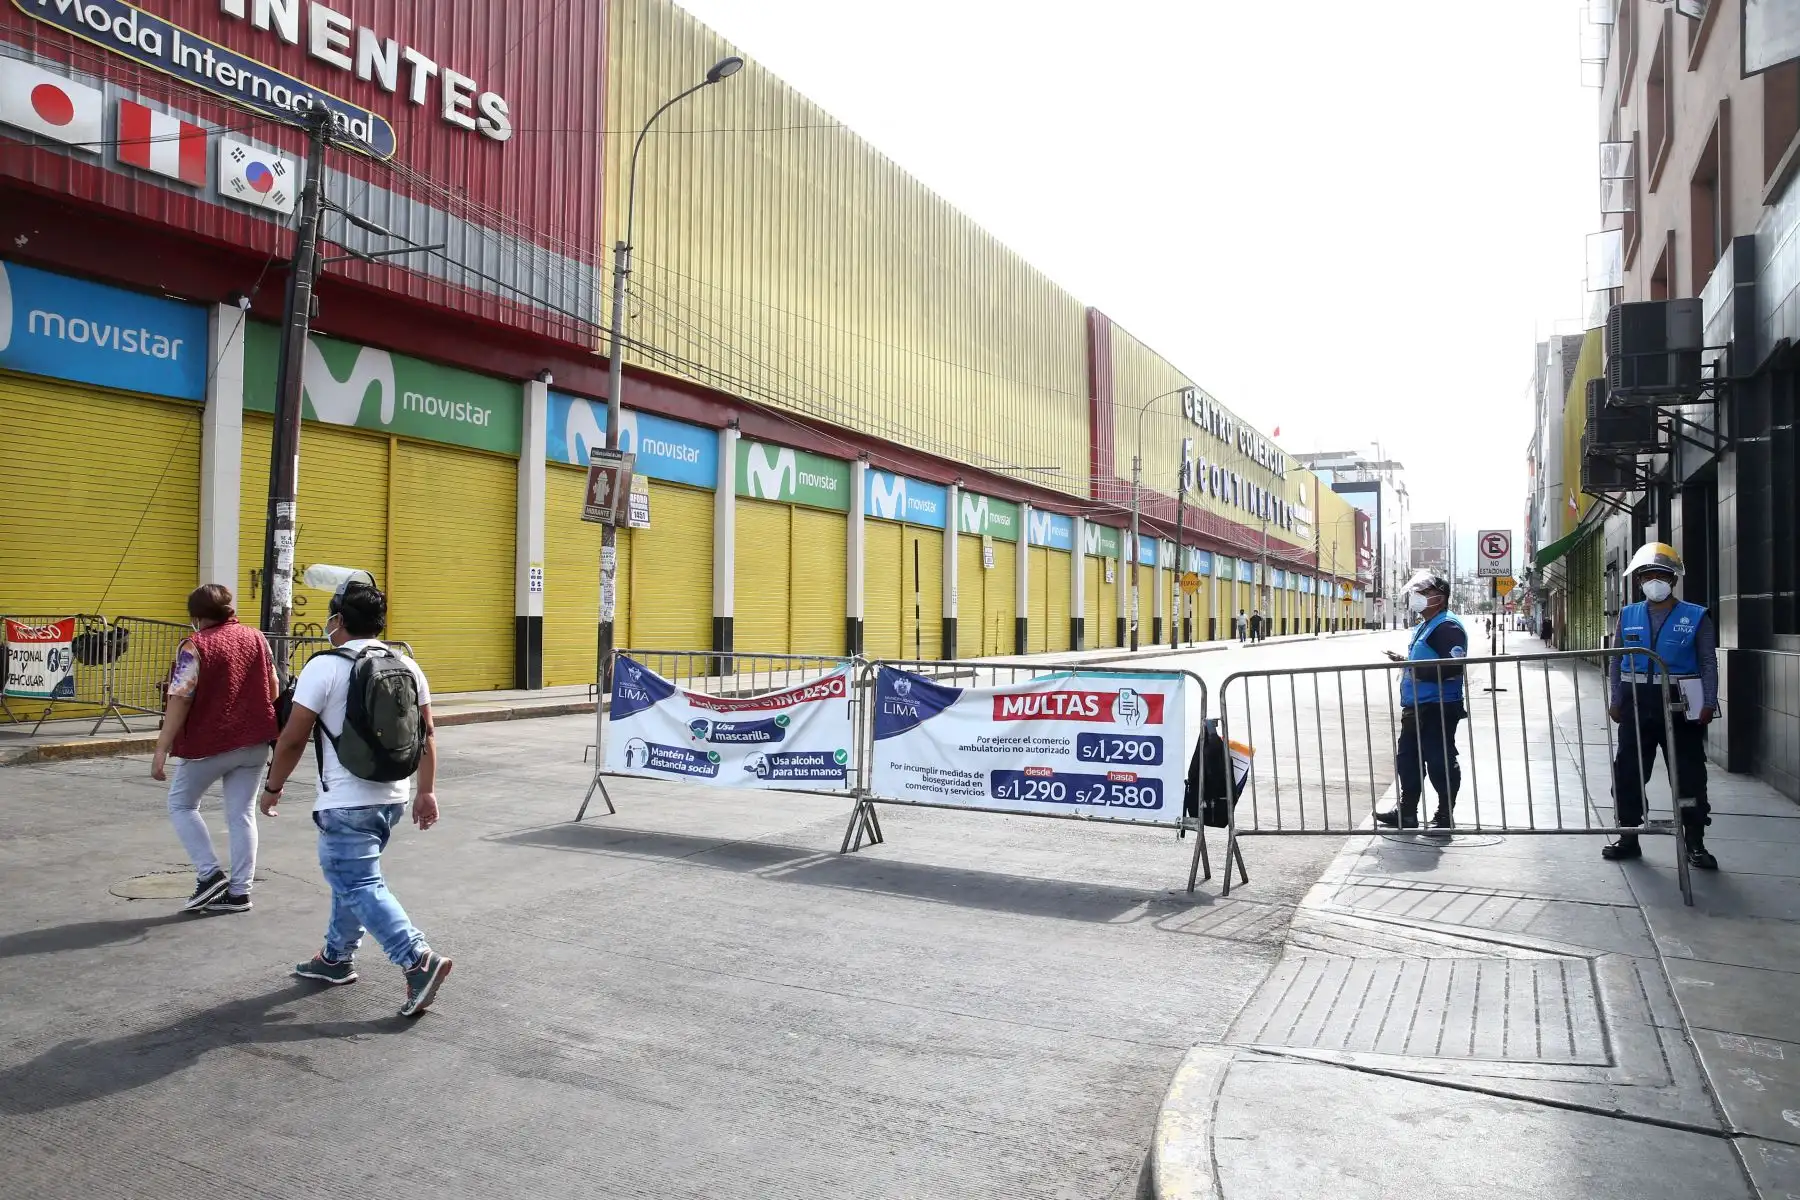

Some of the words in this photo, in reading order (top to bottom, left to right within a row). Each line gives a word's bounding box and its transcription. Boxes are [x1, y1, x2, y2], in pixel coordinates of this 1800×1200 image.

[172, 29, 374, 145] Internacinal
[29, 309, 184, 361] movistar
[403, 391, 491, 427] movistar
[1184, 390, 1232, 444] CENTRO
[1236, 425, 1288, 480] COMERCIAL
[642, 437, 700, 464] movistar
[799, 471, 838, 491] movistar
[1197, 456, 1294, 532] CONTINENTES
[907, 496, 937, 513] movistar
[634, 511, 646, 520] 1451
[1480, 567, 1510, 575] ESTACIONAR
[618, 687, 650, 703] LIMA
[773, 679, 844, 707] INGRESO
[883, 702, 918, 718] LIMA
[1001, 694, 1099, 717] MULTAS
[716, 722, 735, 731] Usa
[715, 730, 771, 741] mascarilla
[976, 735, 991, 744] Por
[992, 736, 1022, 746] ejercer
[1023, 735, 1031, 744] el
[1032, 736, 1070, 746] comercio
[651, 747, 685, 761] Mantén
[685, 752, 695, 762] la
[958, 744, 1011, 753] ambulatorio
[1012, 745, 1024, 753] no
[1025, 745, 1070, 755] autorizado
[651, 757, 687, 771] distancia
[687, 764, 715, 775] social
[772, 756, 790, 766] Usa
[791, 755, 824, 766] alcohol
[772, 768, 793, 779] para
[794, 767, 809, 777] tus
[810, 768, 843, 777] manos
[890, 761, 903, 770] Por
[903, 763, 939, 777] incumplir
[939, 769, 972, 780] medidas
[973, 771, 985, 779] de
[1025, 767, 1051, 777] desde
[1109, 772, 1134, 783] hasta
[922, 774, 971, 788] bioseguridad
[972, 780, 983, 788] en
[905, 782, 944, 793] comercios
[944, 786, 950, 796] y
[950, 786, 985, 797] servicios
